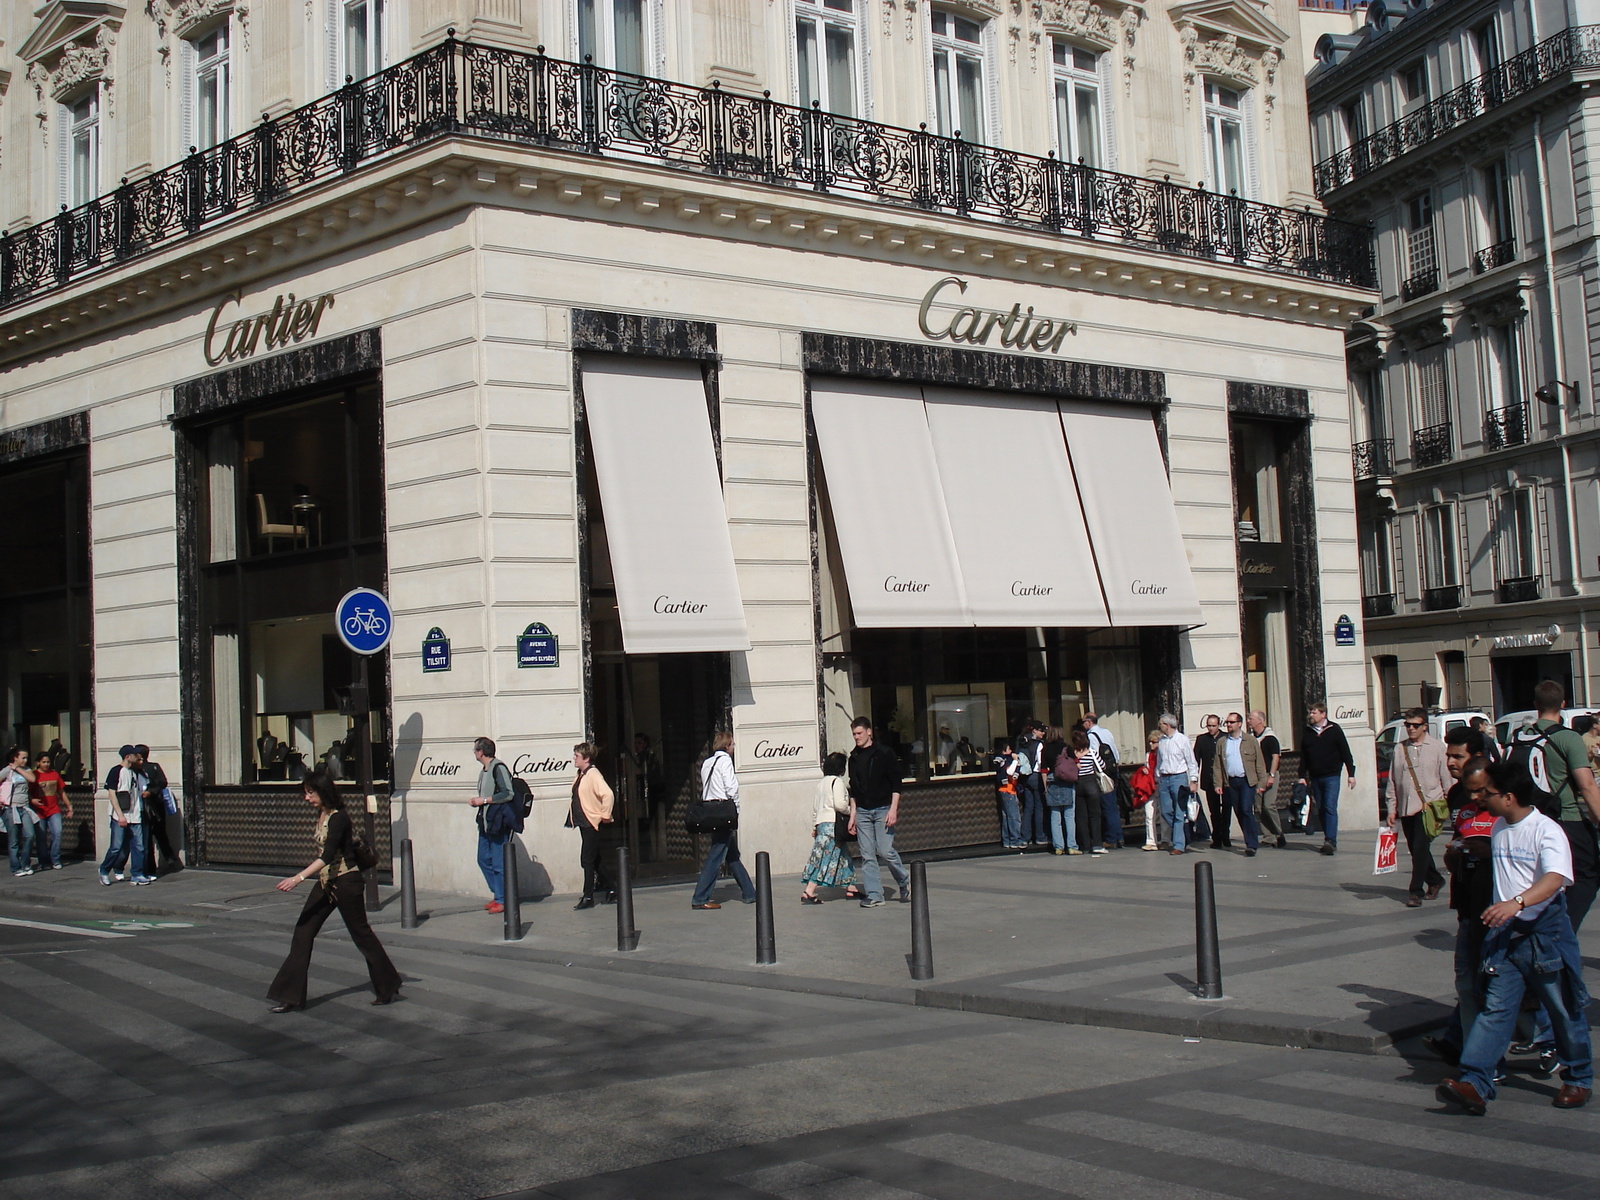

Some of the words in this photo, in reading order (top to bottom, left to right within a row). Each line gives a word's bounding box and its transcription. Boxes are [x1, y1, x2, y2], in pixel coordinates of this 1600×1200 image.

[918, 276, 1077, 352] Cartier
[204, 290, 335, 365] Cartier
[1242, 558, 1276, 574] Cartier
[884, 575, 930, 593] Cartier
[1011, 581, 1053, 597] Cartier
[1131, 579, 1168, 595] Cartier
[653, 595, 708, 614] Cartier
[430, 646, 442, 655] RUE
[426, 656, 447, 666] TILSITT
[1335, 705, 1364, 720] Cartier
[753, 739, 804, 759] Cartier
[420, 756, 461, 776] Cartier
[513, 753, 571, 775] Cartier
